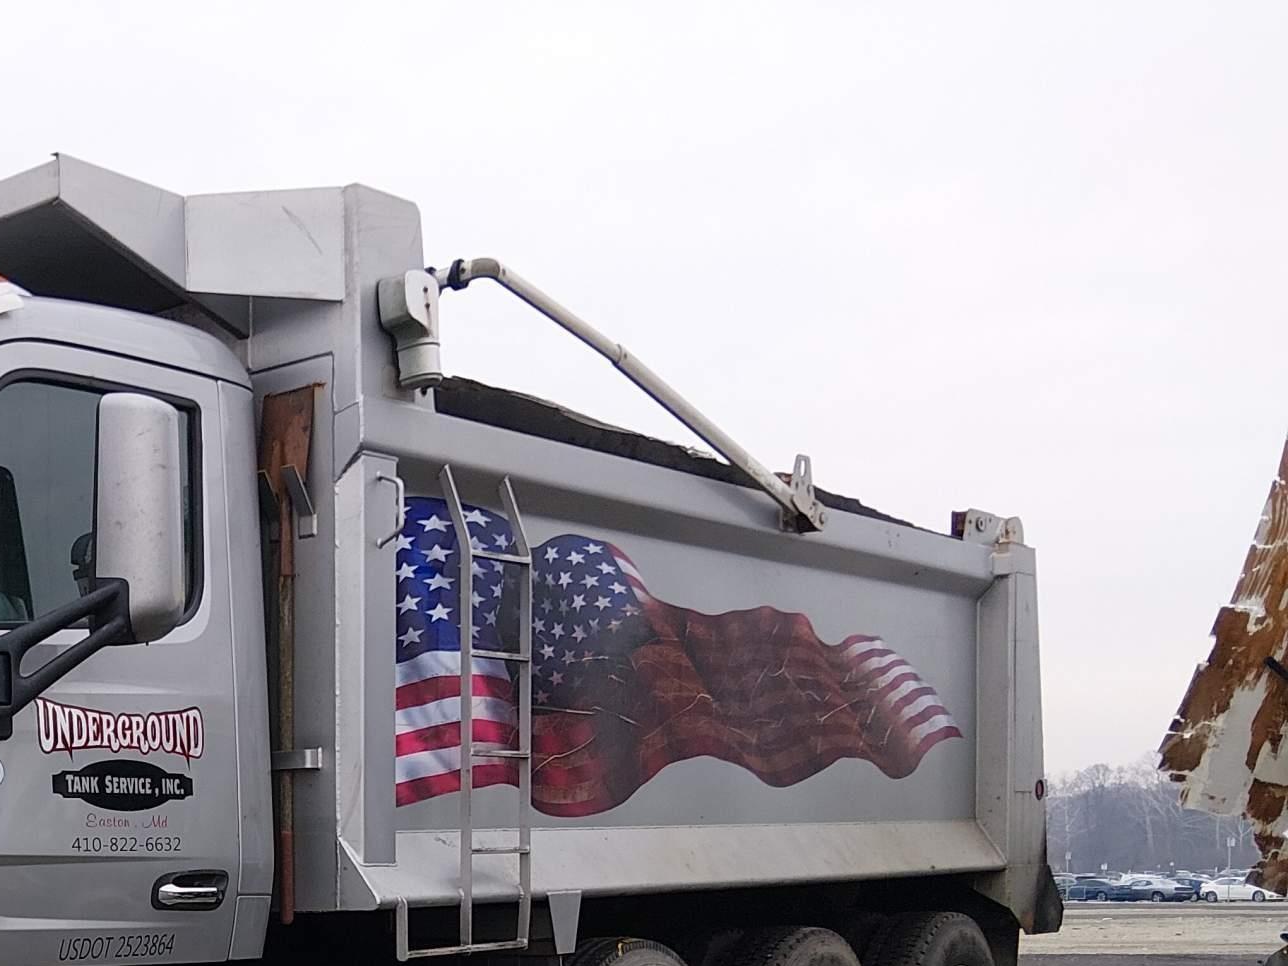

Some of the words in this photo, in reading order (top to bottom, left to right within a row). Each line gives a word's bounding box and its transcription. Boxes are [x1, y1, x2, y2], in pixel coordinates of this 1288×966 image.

[34, 697, 205, 766] UNDERGROUND
[65, 774, 100, 794] TANK
[162, 778, 185, 796] INC.
[142, 815, 168, 829] Md
[71, 836, 182, 853] 410-822-6632
[58, 936, 114, 961] USDOT
[114, 933, 176, 958] 2523864
